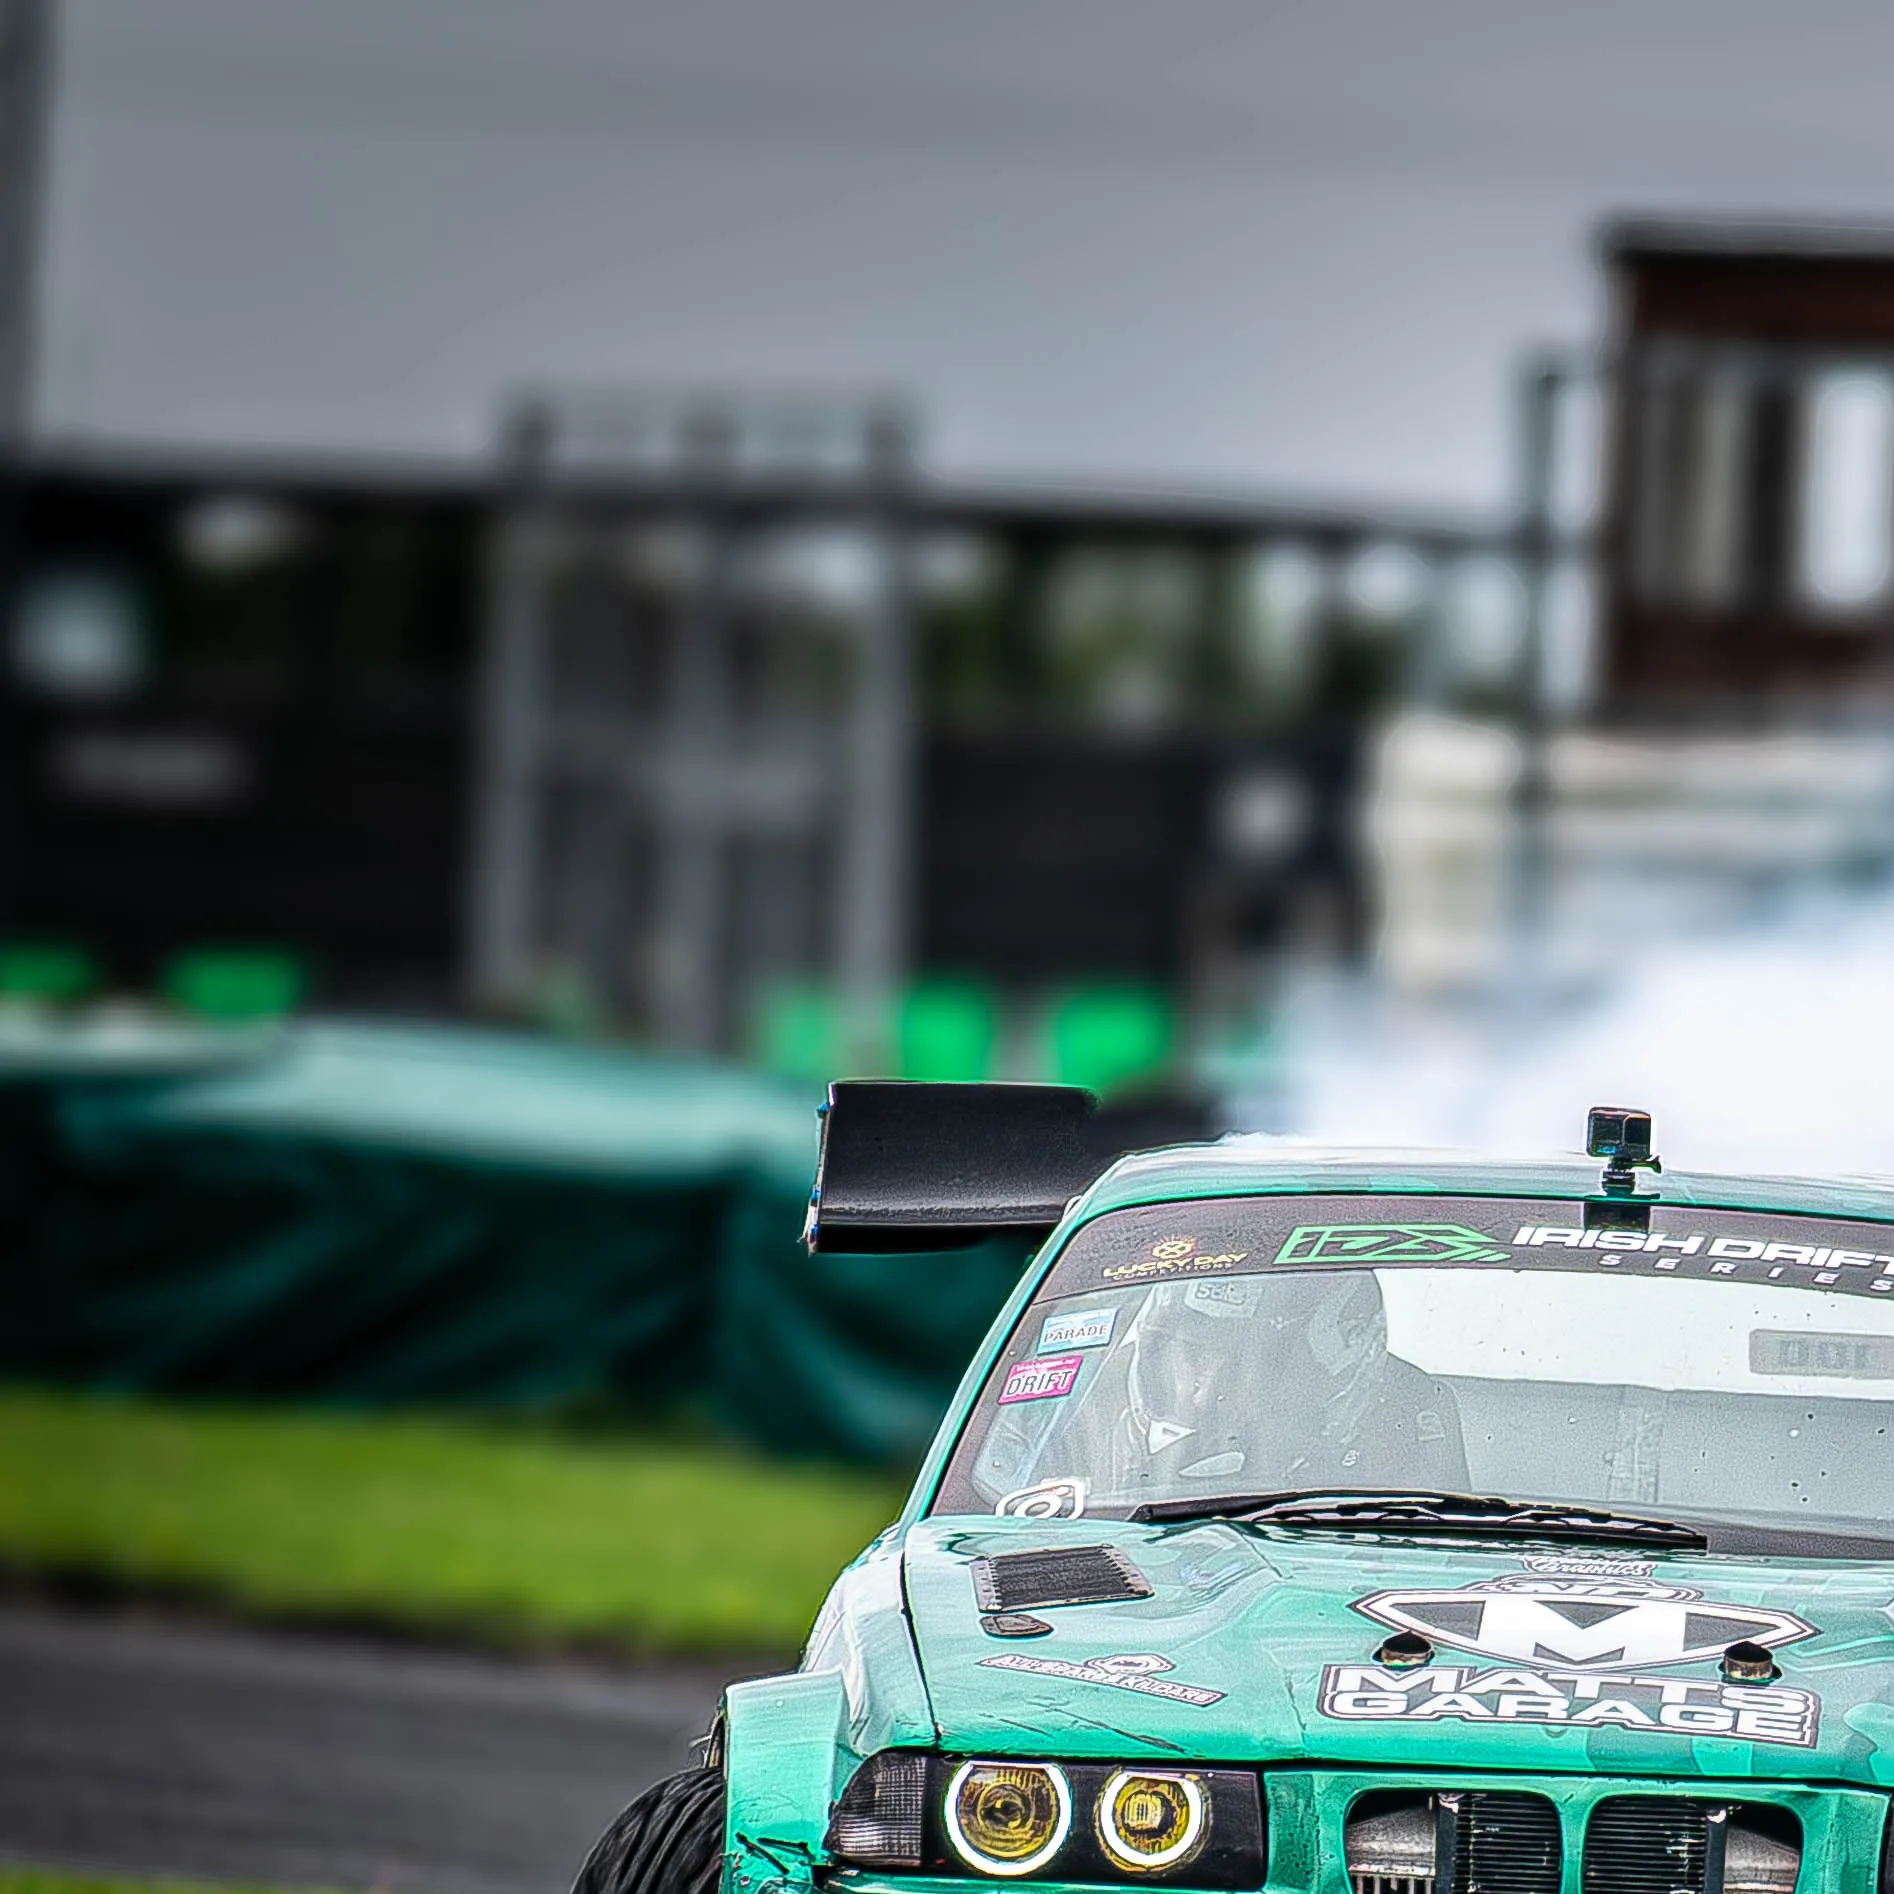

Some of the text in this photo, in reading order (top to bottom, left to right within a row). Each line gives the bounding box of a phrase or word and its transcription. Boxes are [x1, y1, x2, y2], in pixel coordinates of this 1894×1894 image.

[1511, 1226, 1701, 1255] IRISH
[1103, 1252, 1248, 1277] LUCKY DAY
[1044, 1325, 1109, 1343] PARADE
[1006, 1370, 1072, 1396] DRIFT
[1345, 1667, 1809, 1714] MATTS
[1334, 1689, 1803, 1739] GARAGE
